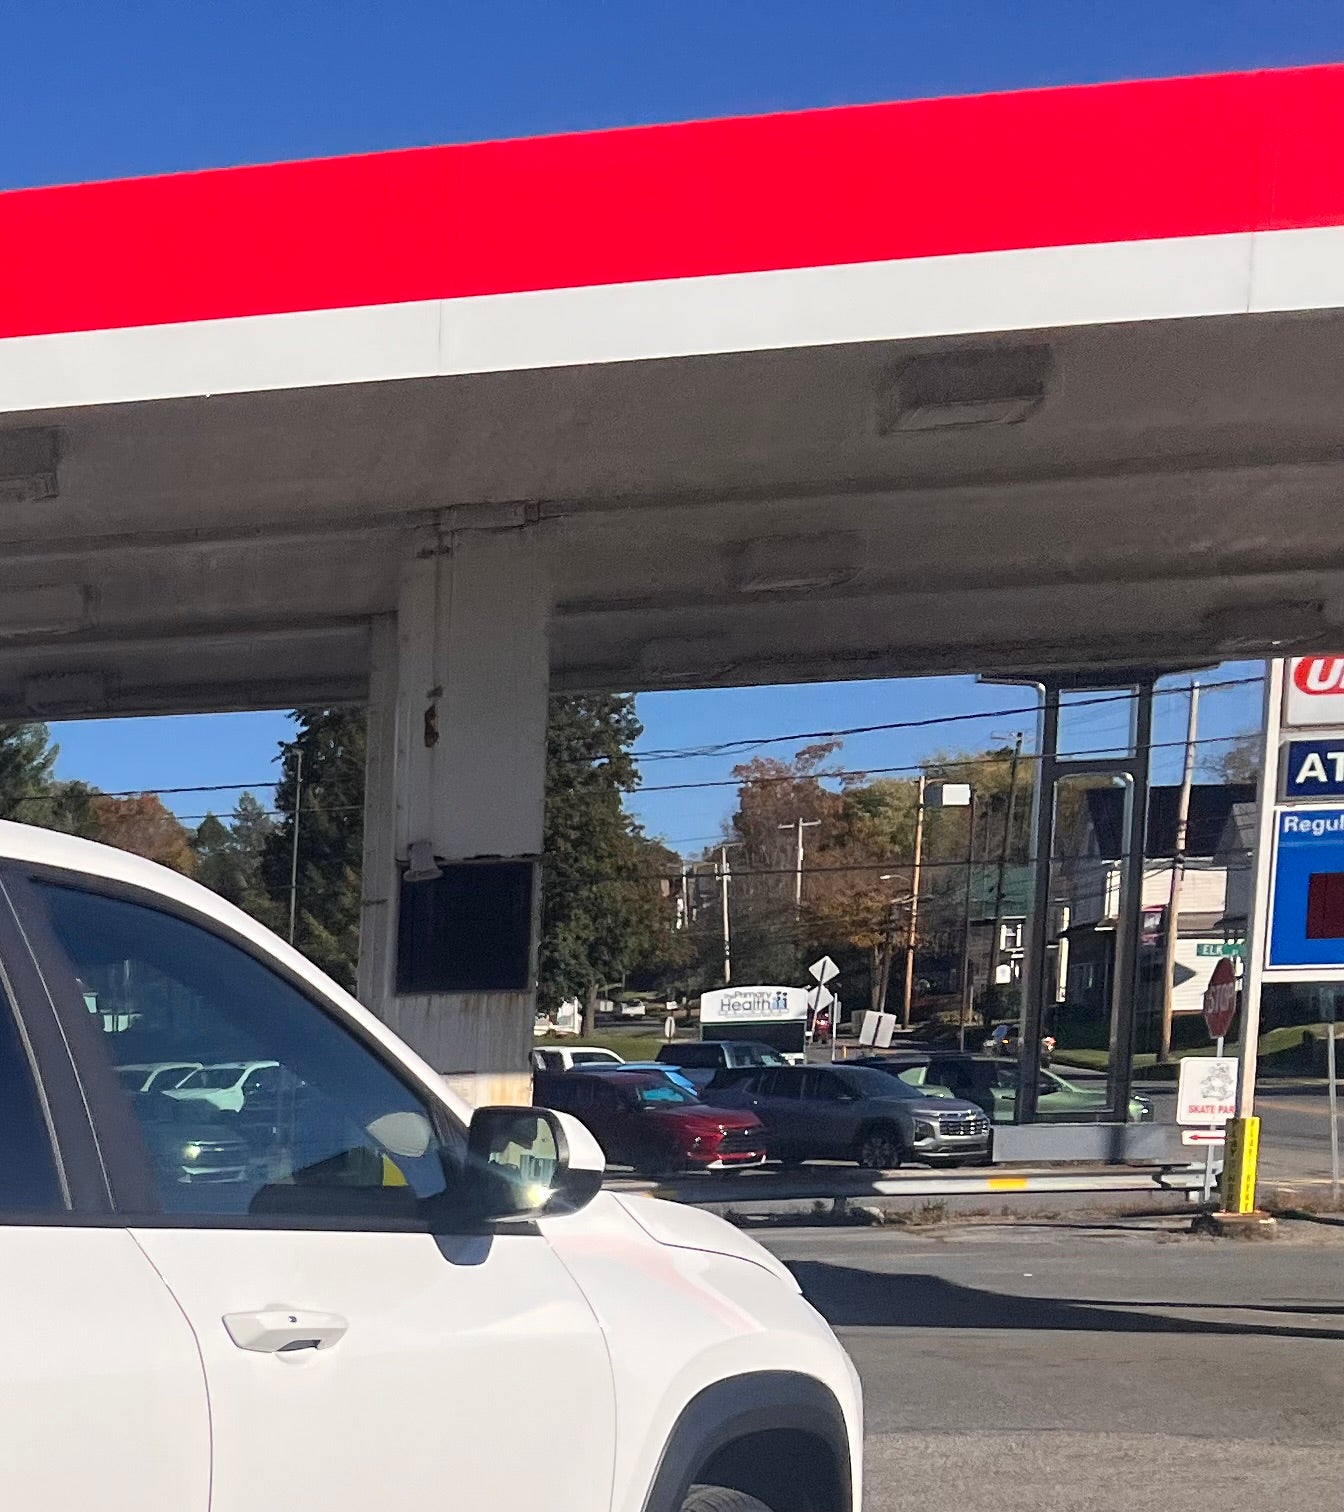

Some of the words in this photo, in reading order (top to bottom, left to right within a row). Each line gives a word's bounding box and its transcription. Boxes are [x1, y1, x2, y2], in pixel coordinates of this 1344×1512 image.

[720, 998, 771, 1011] Health
[1205, 984, 1235, 1014] STOP
[1188, 1104, 1216, 1114] SKATE
